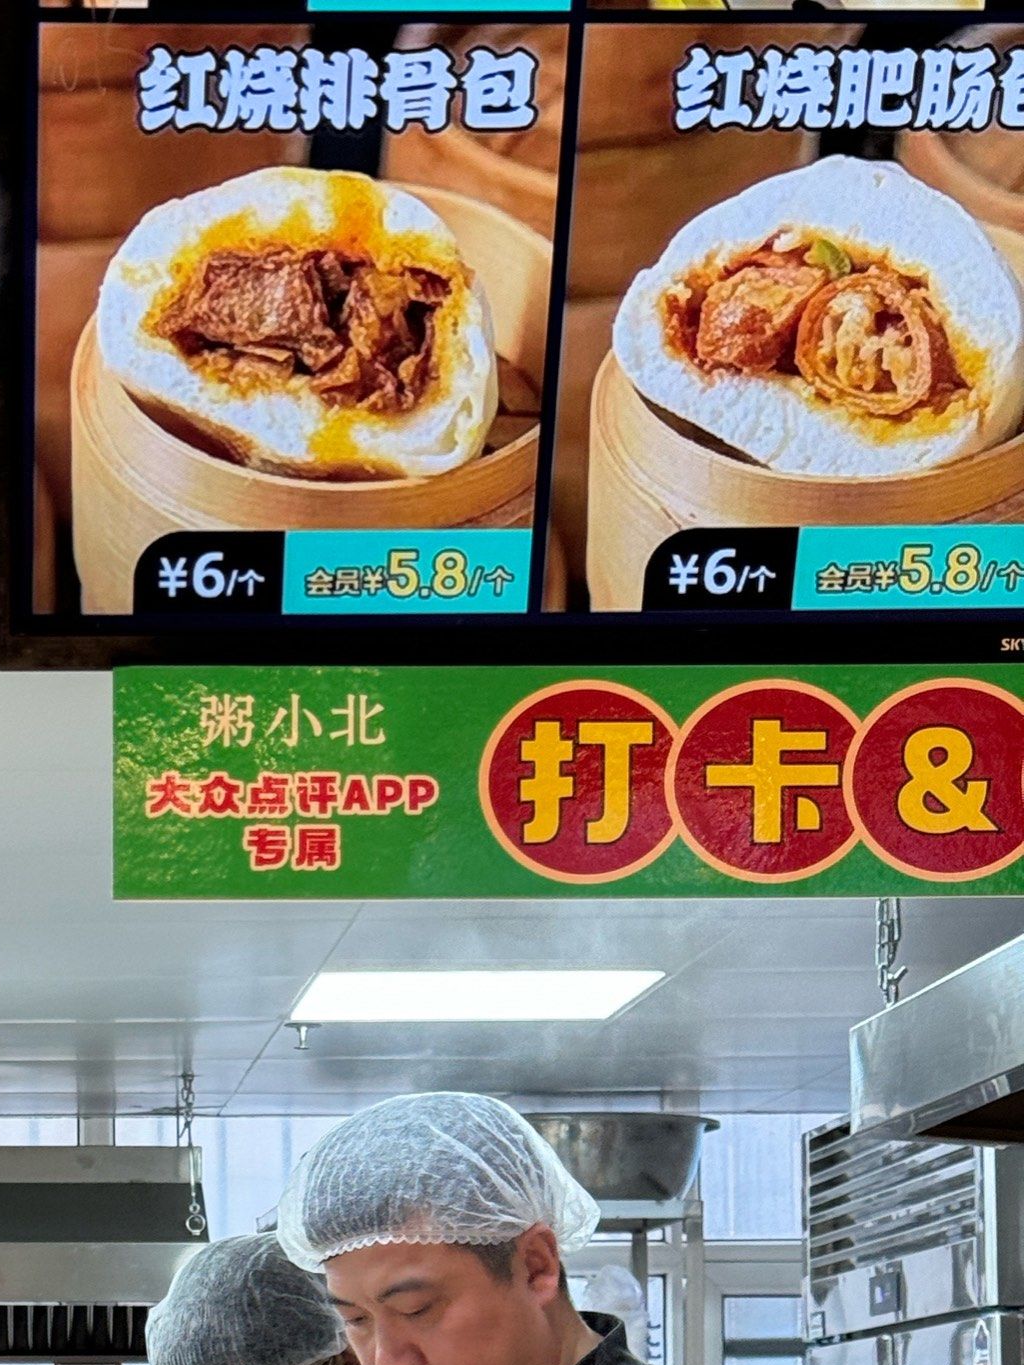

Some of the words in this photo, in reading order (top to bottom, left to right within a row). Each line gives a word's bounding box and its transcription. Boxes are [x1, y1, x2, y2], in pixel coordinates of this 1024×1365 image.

[138, 47, 536, 131] 红烧排骨包
[159, 550, 265, 598] ¥6/个
[305, 549, 514, 598] 会员¥5.8/个
[670, 548, 775, 596] ¥6/个
[201, 694, 386, 748] 粥小北
[146, 770, 439, 818] 大众点评APP
[518, 718, 1002, 846] 打卡&
[243, 825, 342, 871] 专属
